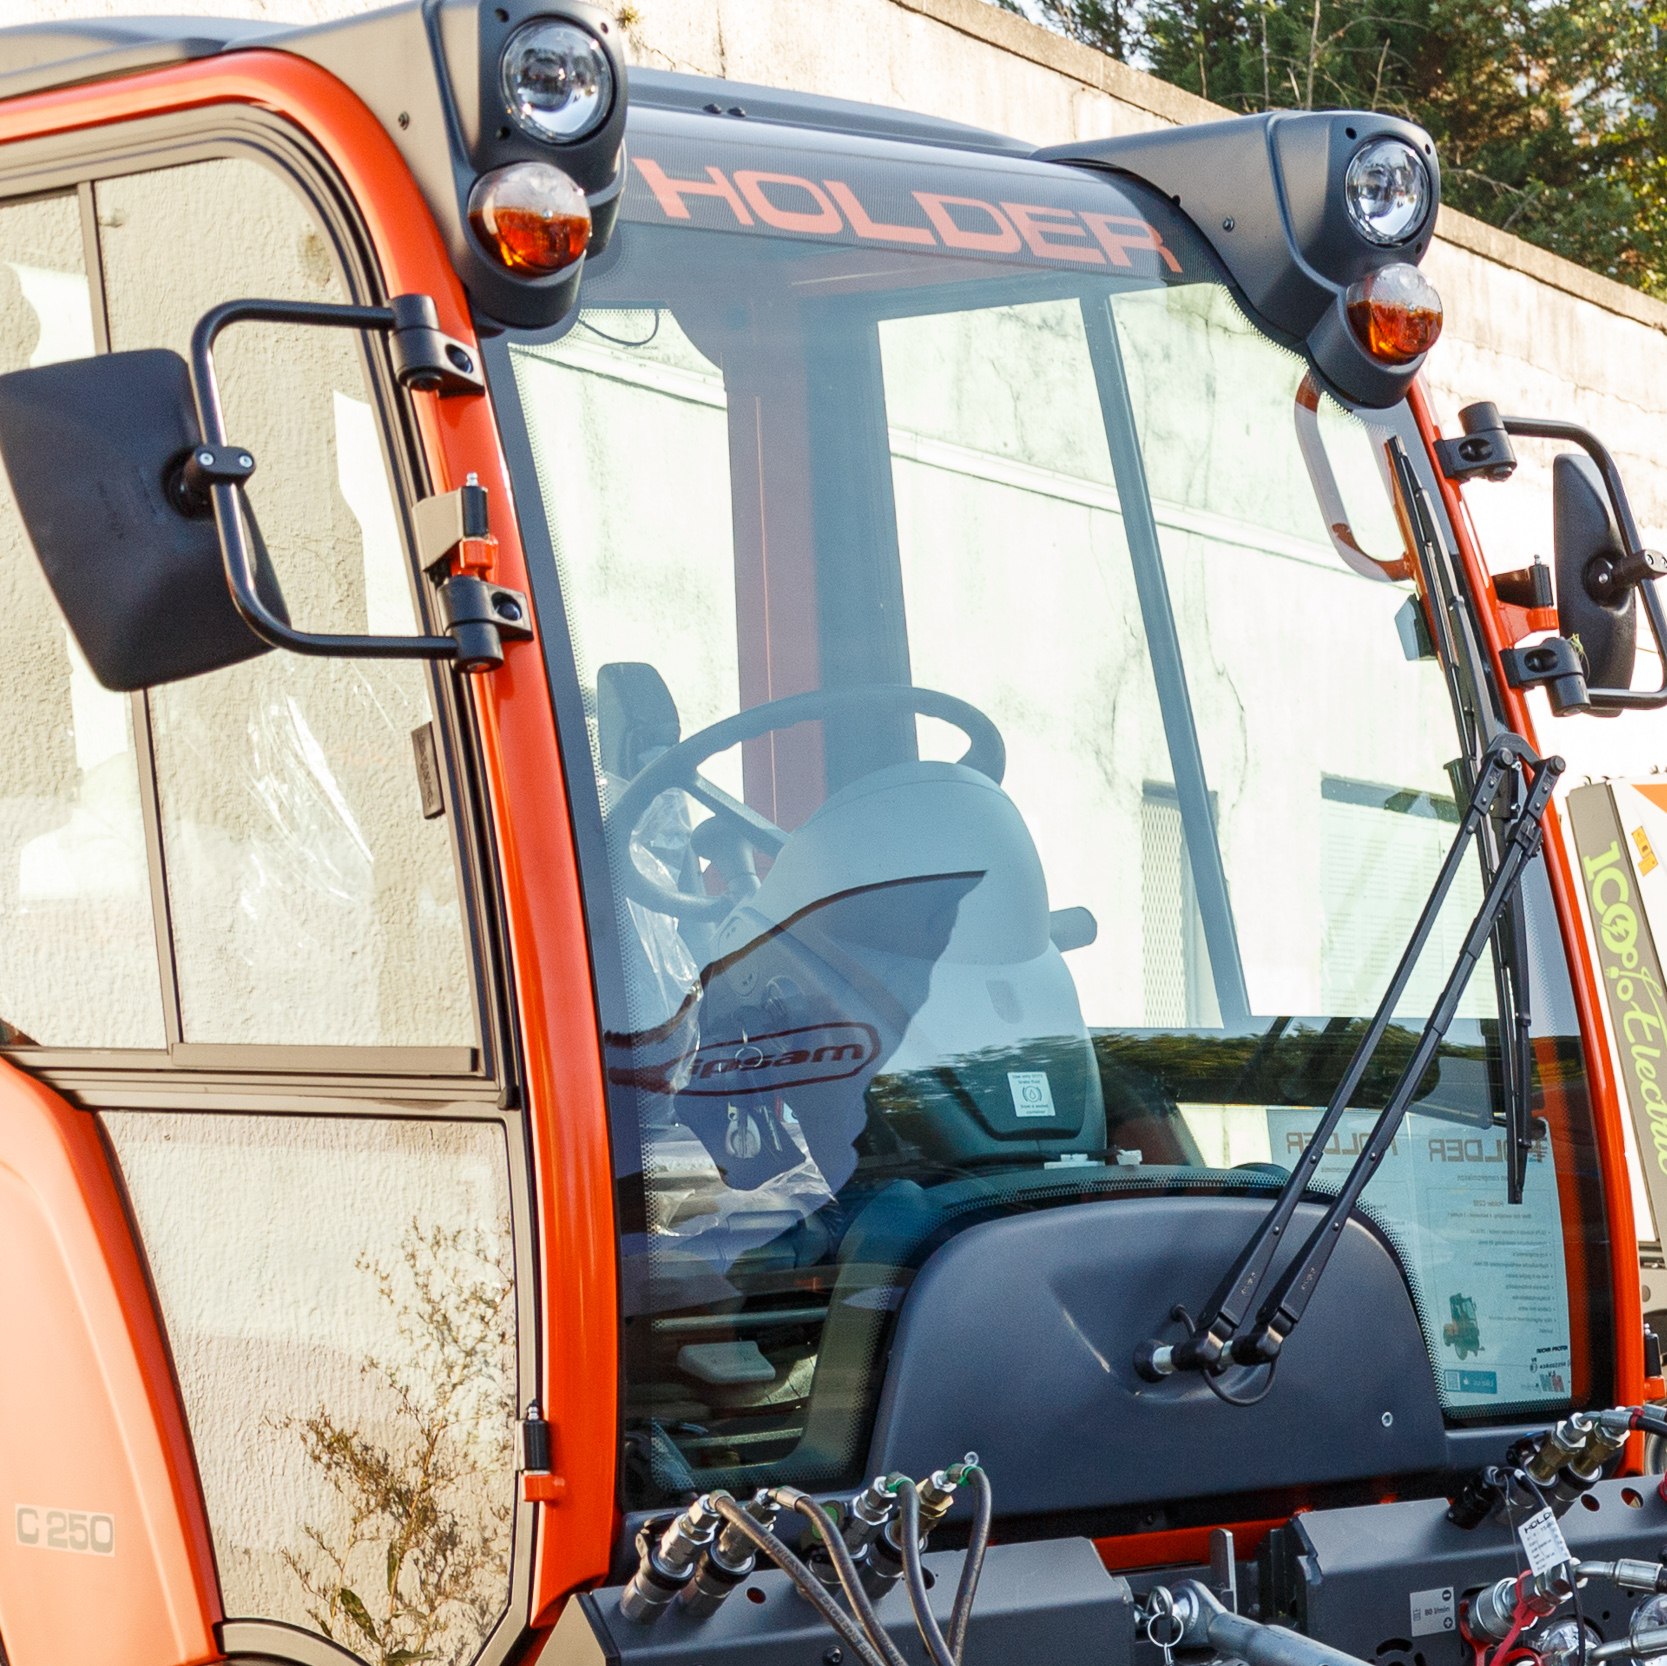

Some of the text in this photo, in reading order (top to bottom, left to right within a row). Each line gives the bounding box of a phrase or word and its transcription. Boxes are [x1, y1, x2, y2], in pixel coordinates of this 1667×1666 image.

[631, 157, 1184, 273] HOLDER
[17, 1508, 114, 1552] C 250
